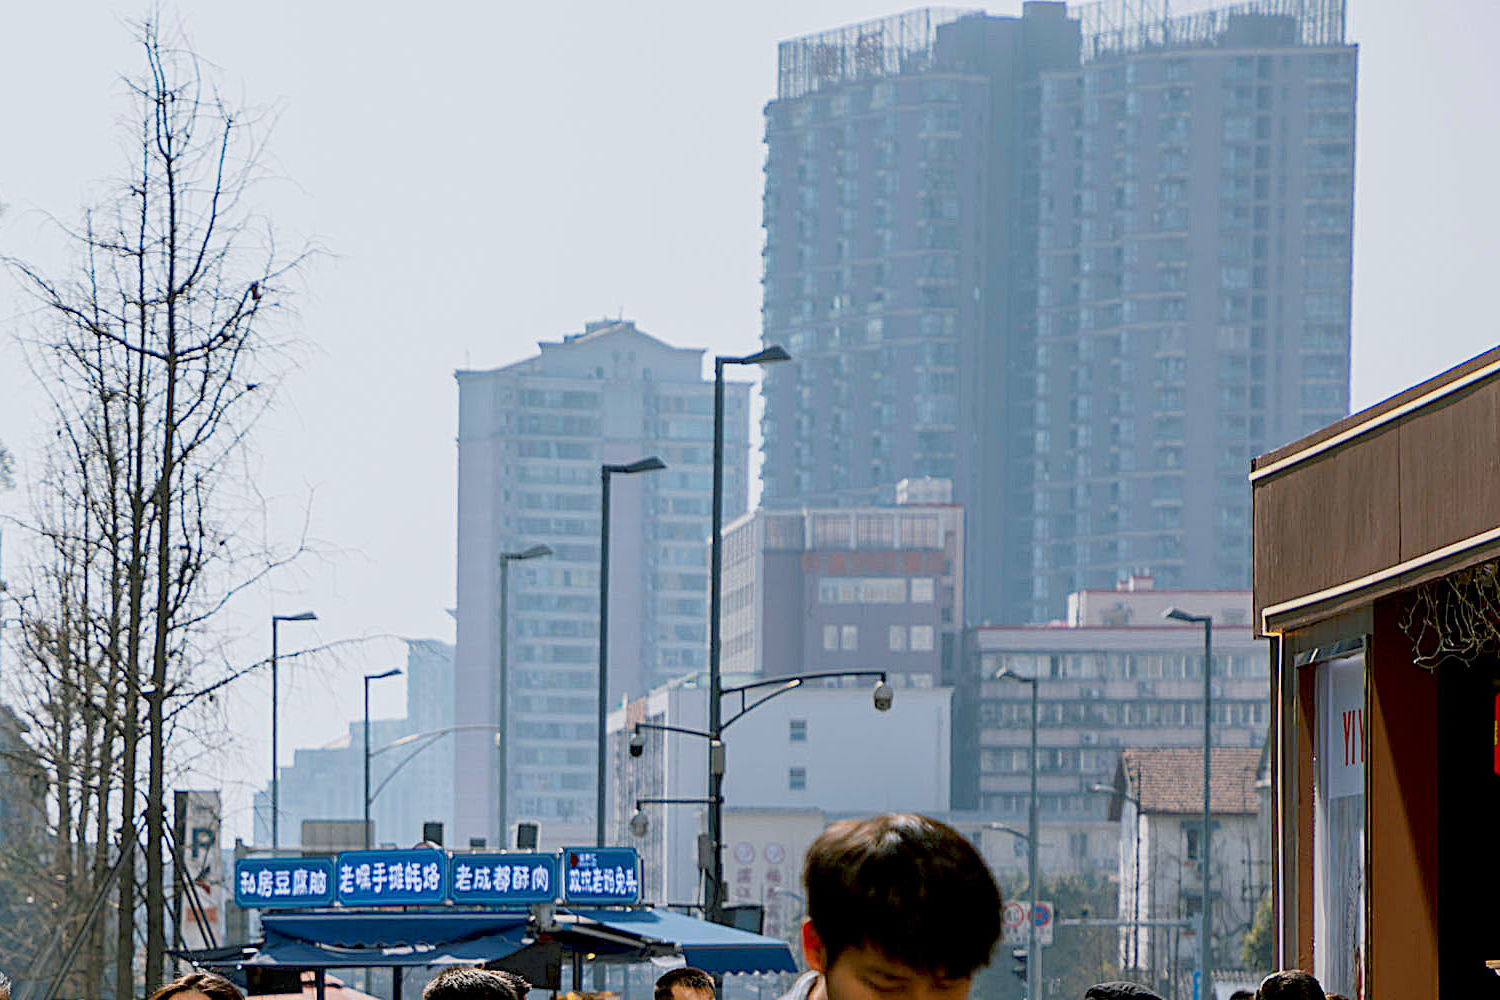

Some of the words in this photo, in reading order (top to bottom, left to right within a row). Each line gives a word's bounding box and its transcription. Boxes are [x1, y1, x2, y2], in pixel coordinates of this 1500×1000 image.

[455, 864, 549, 894] 老成都酥肉
